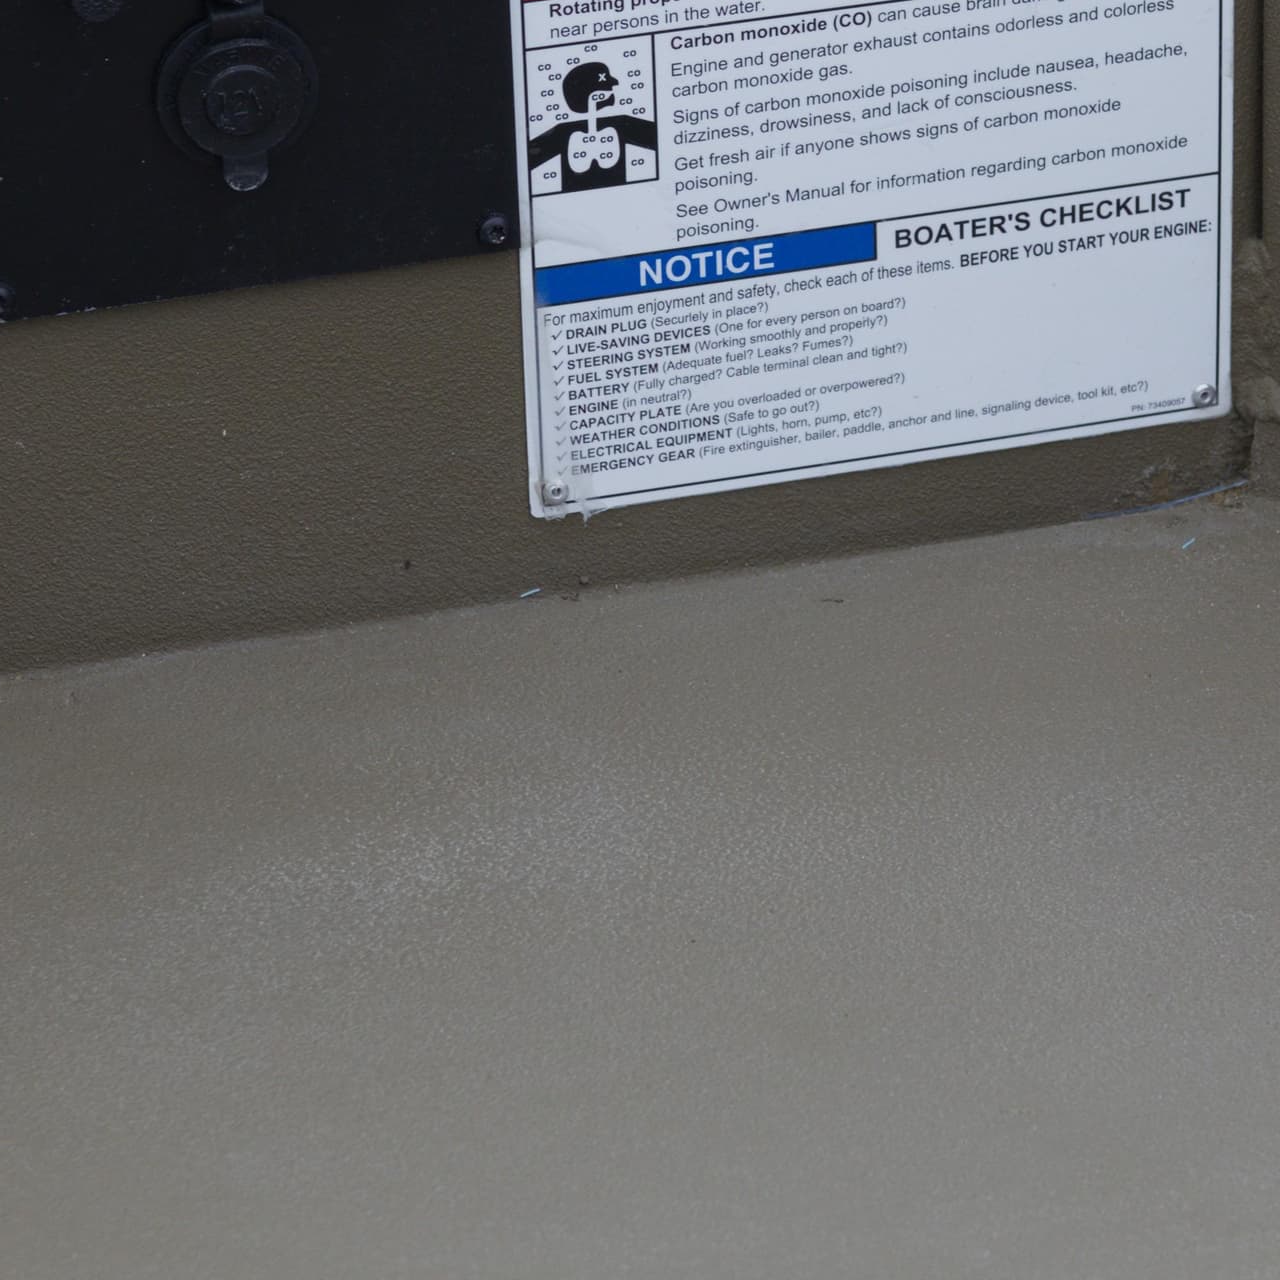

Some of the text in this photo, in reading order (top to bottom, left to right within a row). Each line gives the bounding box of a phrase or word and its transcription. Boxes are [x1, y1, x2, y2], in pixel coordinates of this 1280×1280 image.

[550, 0, 765, 39] near persons in the water.
[670, 32, 735, 50] Carbon
[740, 17, 828, 41] monoxide
[833, 10, 872, 33] (CO)
[877, 9, 907, 23] can
[912, 2, 961, 18] cause
[671, 0, 1175, 78] Engine and generator exhaust contains odorless and colorless
[895, 188, 1191, 249] BOATER'S CHECKLIST
[543, 219, 1212, 327] For maximum enjoyment and safety, check each of these items. BEFORE YOU START YOUR ENGINE:
[639, 242, 775, 287] NOTICE
[565, 324, 607, 340] DRAIN
[610, 318, 648, 334] PLUG
[712, 310, 722, 319] in
[726, 302, 769, 319] place?)
[567, 335, 853, 386] FUEL SYSTEM (Adequate fuel? Leaks? Fumes?)
[568, 388, 692, 416] ENGINE (in neutral?)
